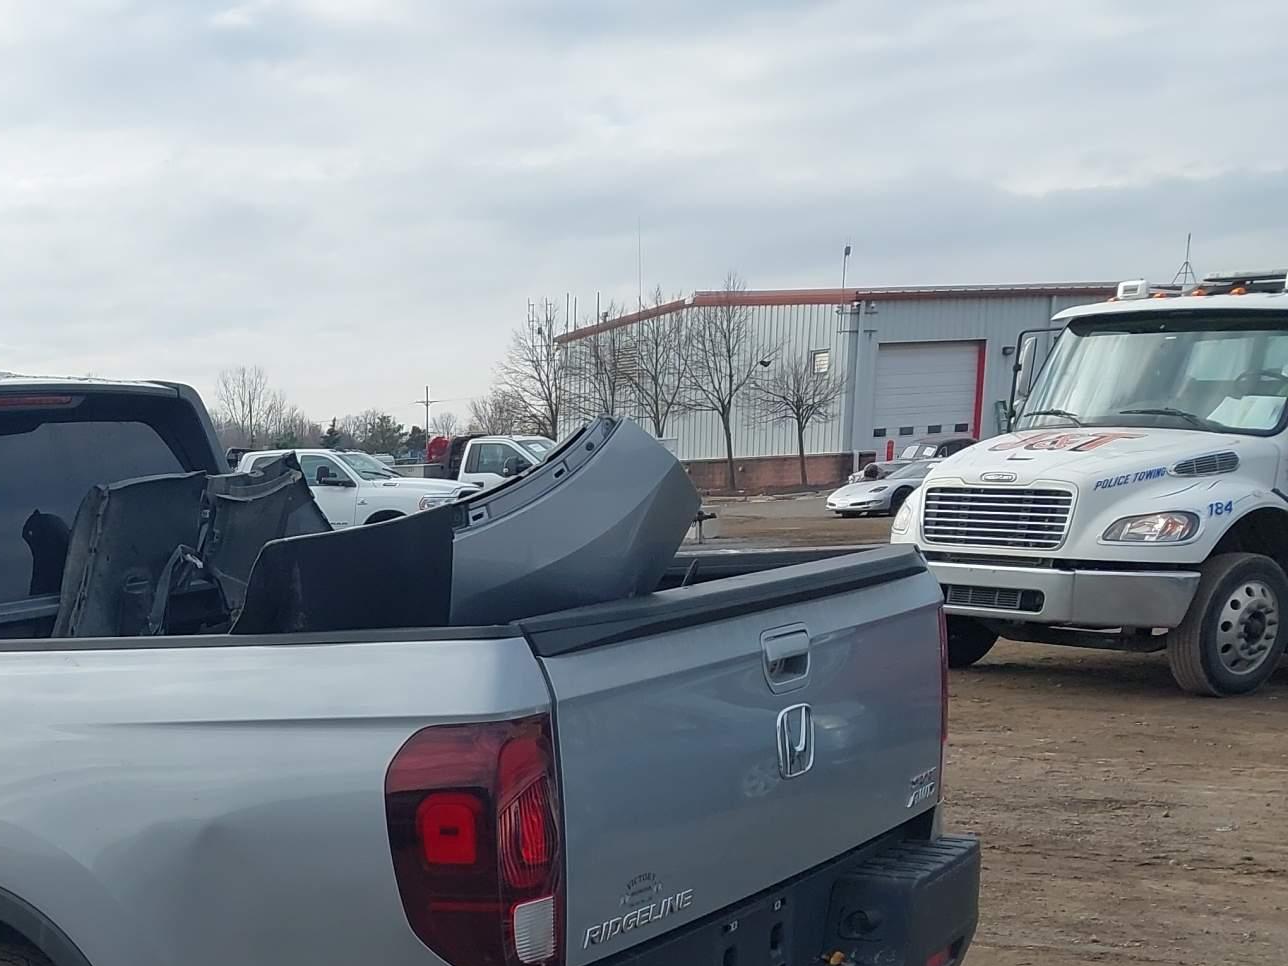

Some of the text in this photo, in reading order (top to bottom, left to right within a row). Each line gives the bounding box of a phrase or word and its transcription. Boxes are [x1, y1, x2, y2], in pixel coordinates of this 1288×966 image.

[1093, 466, 1167, 491] POLICE TOWING
[1208, 500, 1234, 517] 184
[583, 888, 694, 950] RIDGELINE
